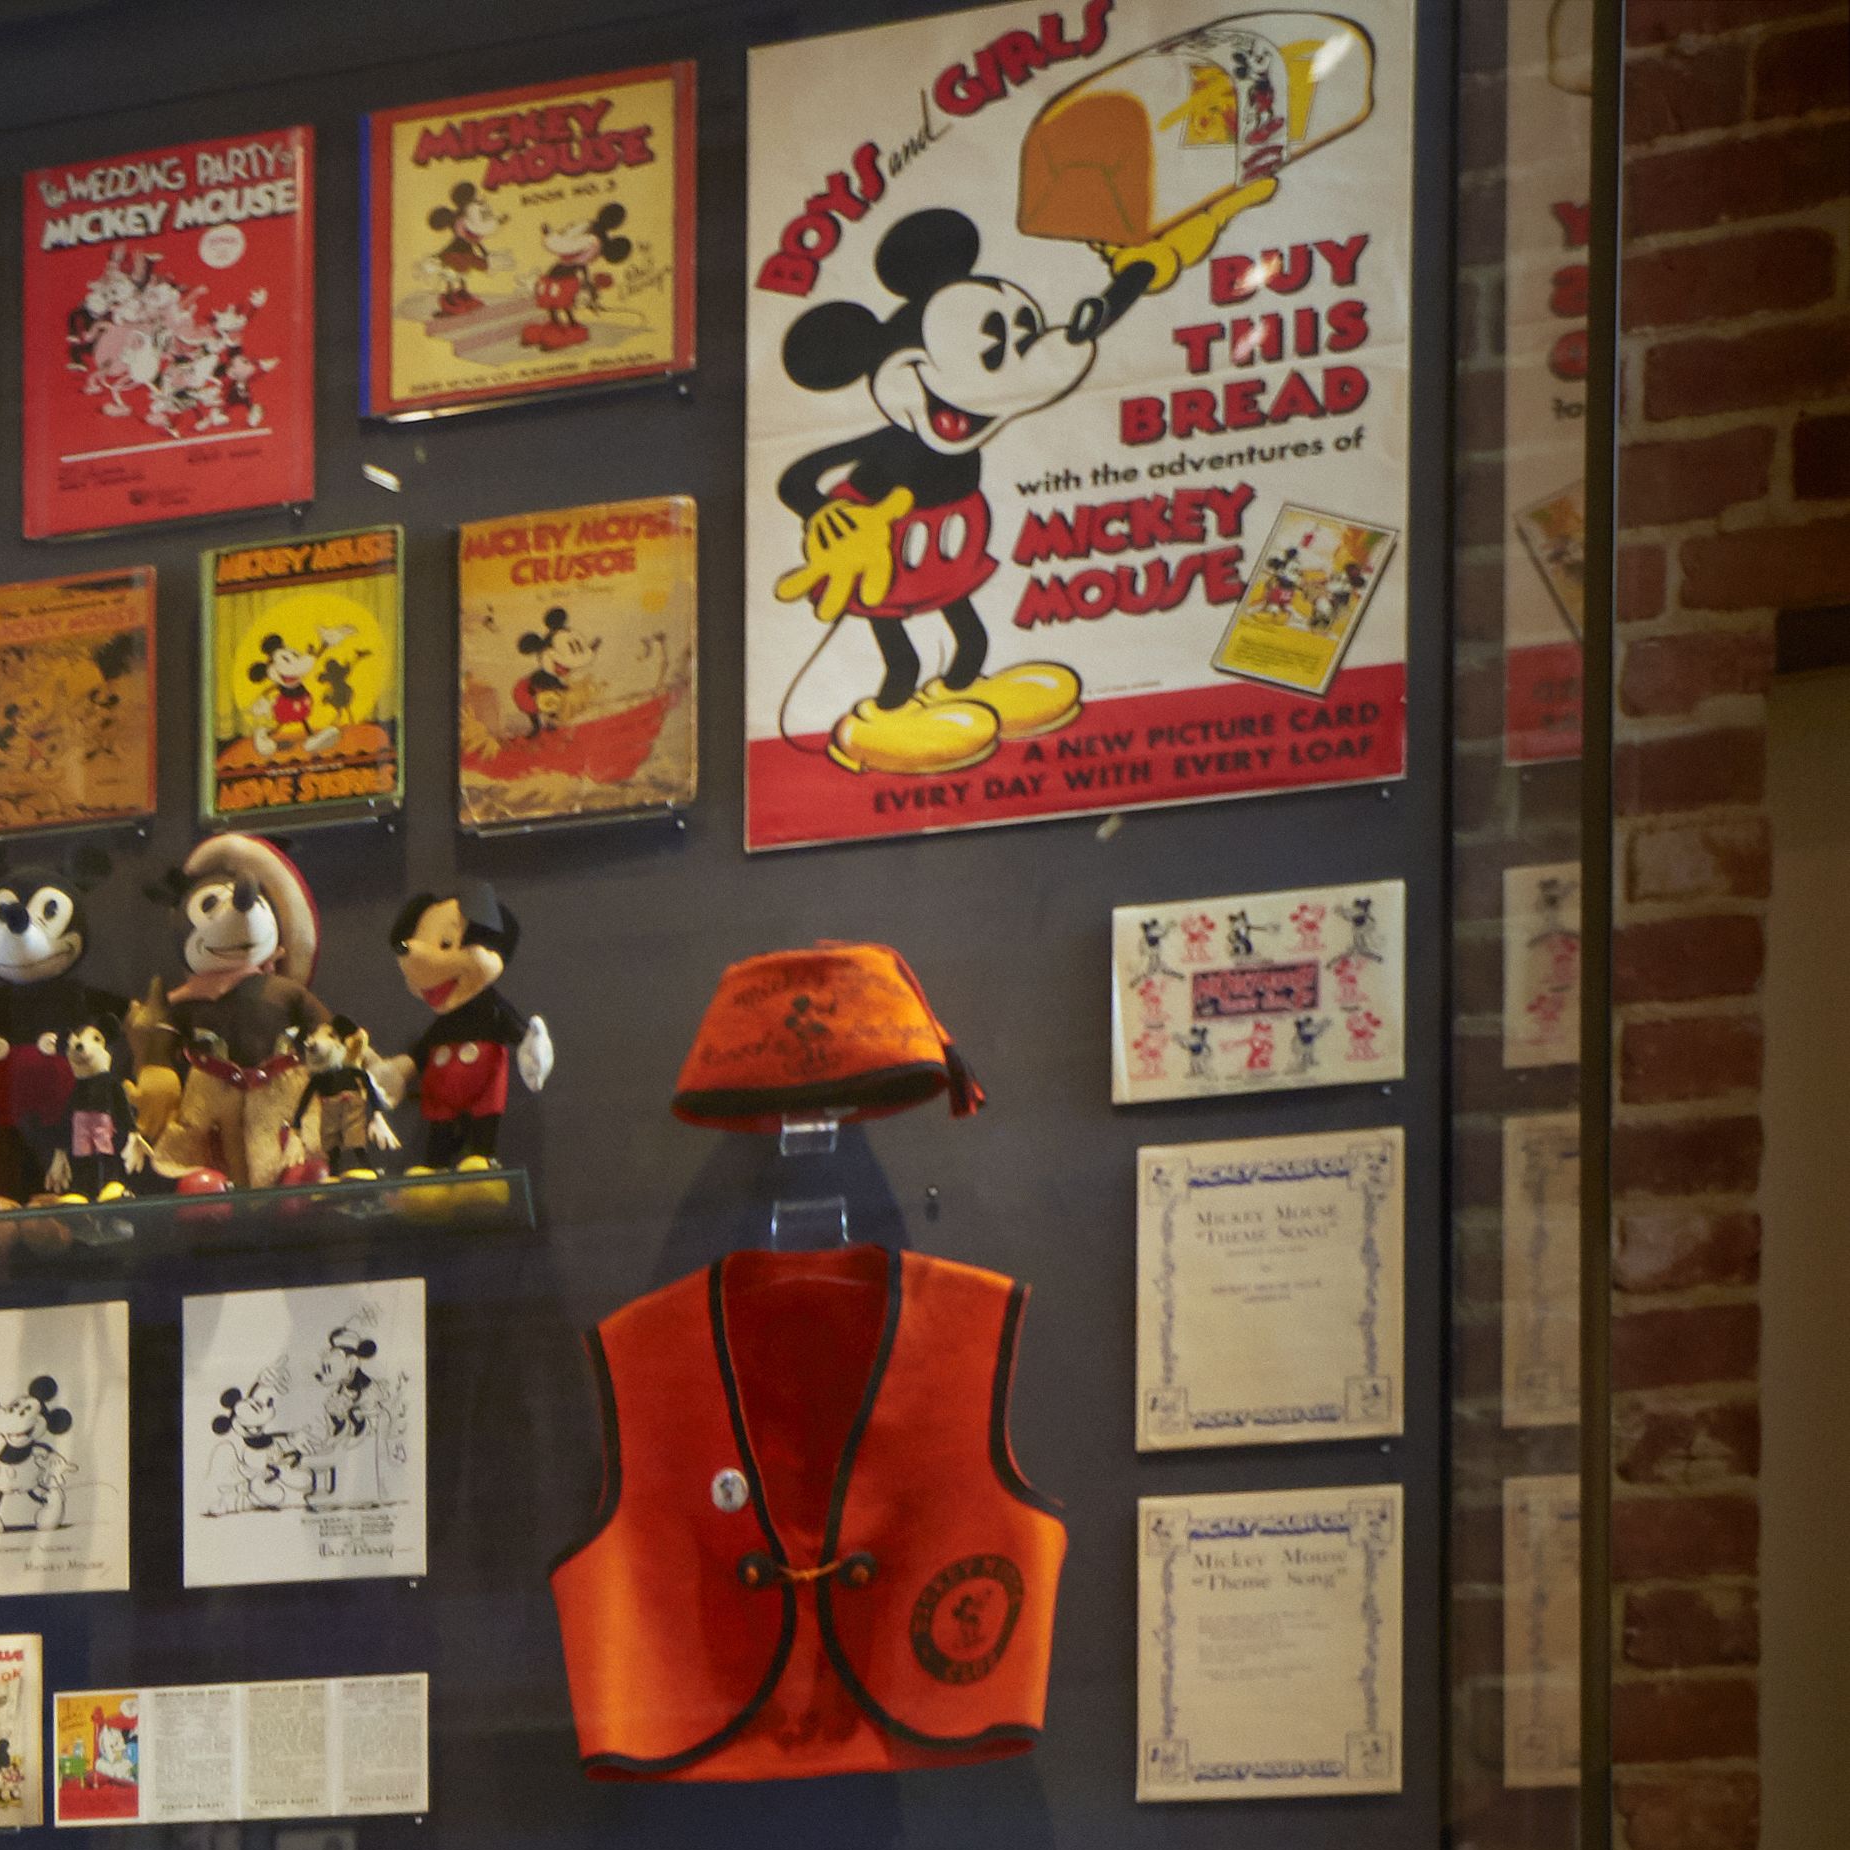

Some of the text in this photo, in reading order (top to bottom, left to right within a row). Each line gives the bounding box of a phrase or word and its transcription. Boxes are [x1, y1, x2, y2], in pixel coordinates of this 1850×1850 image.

[413, 98, 613, 167] MICKEY
[483, 125, 655, 191] MOUSE
[756, 142, 886, 297] BOYS
[889, 88, 954, 177] and
[933, 0, 1114, 117] GIRLS
[66, 157, 185, 201] WEDDING
[197, 142, 282, 185] PARTY
[41, 179, 299, 250] MICKEY MOUSE
[1209, 234, 1369, 305] BUY
[1173, 300, 1368, 374] THIS
[1119, 366, 1369, 446] BREAD
[1017, 425, 1365, 498] with the adventures of
[217, 530, 397, 587] MICKEY MOUSE
[464, 522, 573, 563] MICKEY
[1012, 482, 1256, 567] MICKEY
[511, 548, 637, 586] CRUSOE
[1012, 544, 1250, 631] MOUSE
[1023, 702, 1381, 764] A NEW PICTURE CARD
[873, 735, 1375, 815] EVERY DAY WITH EVERY LOAF
